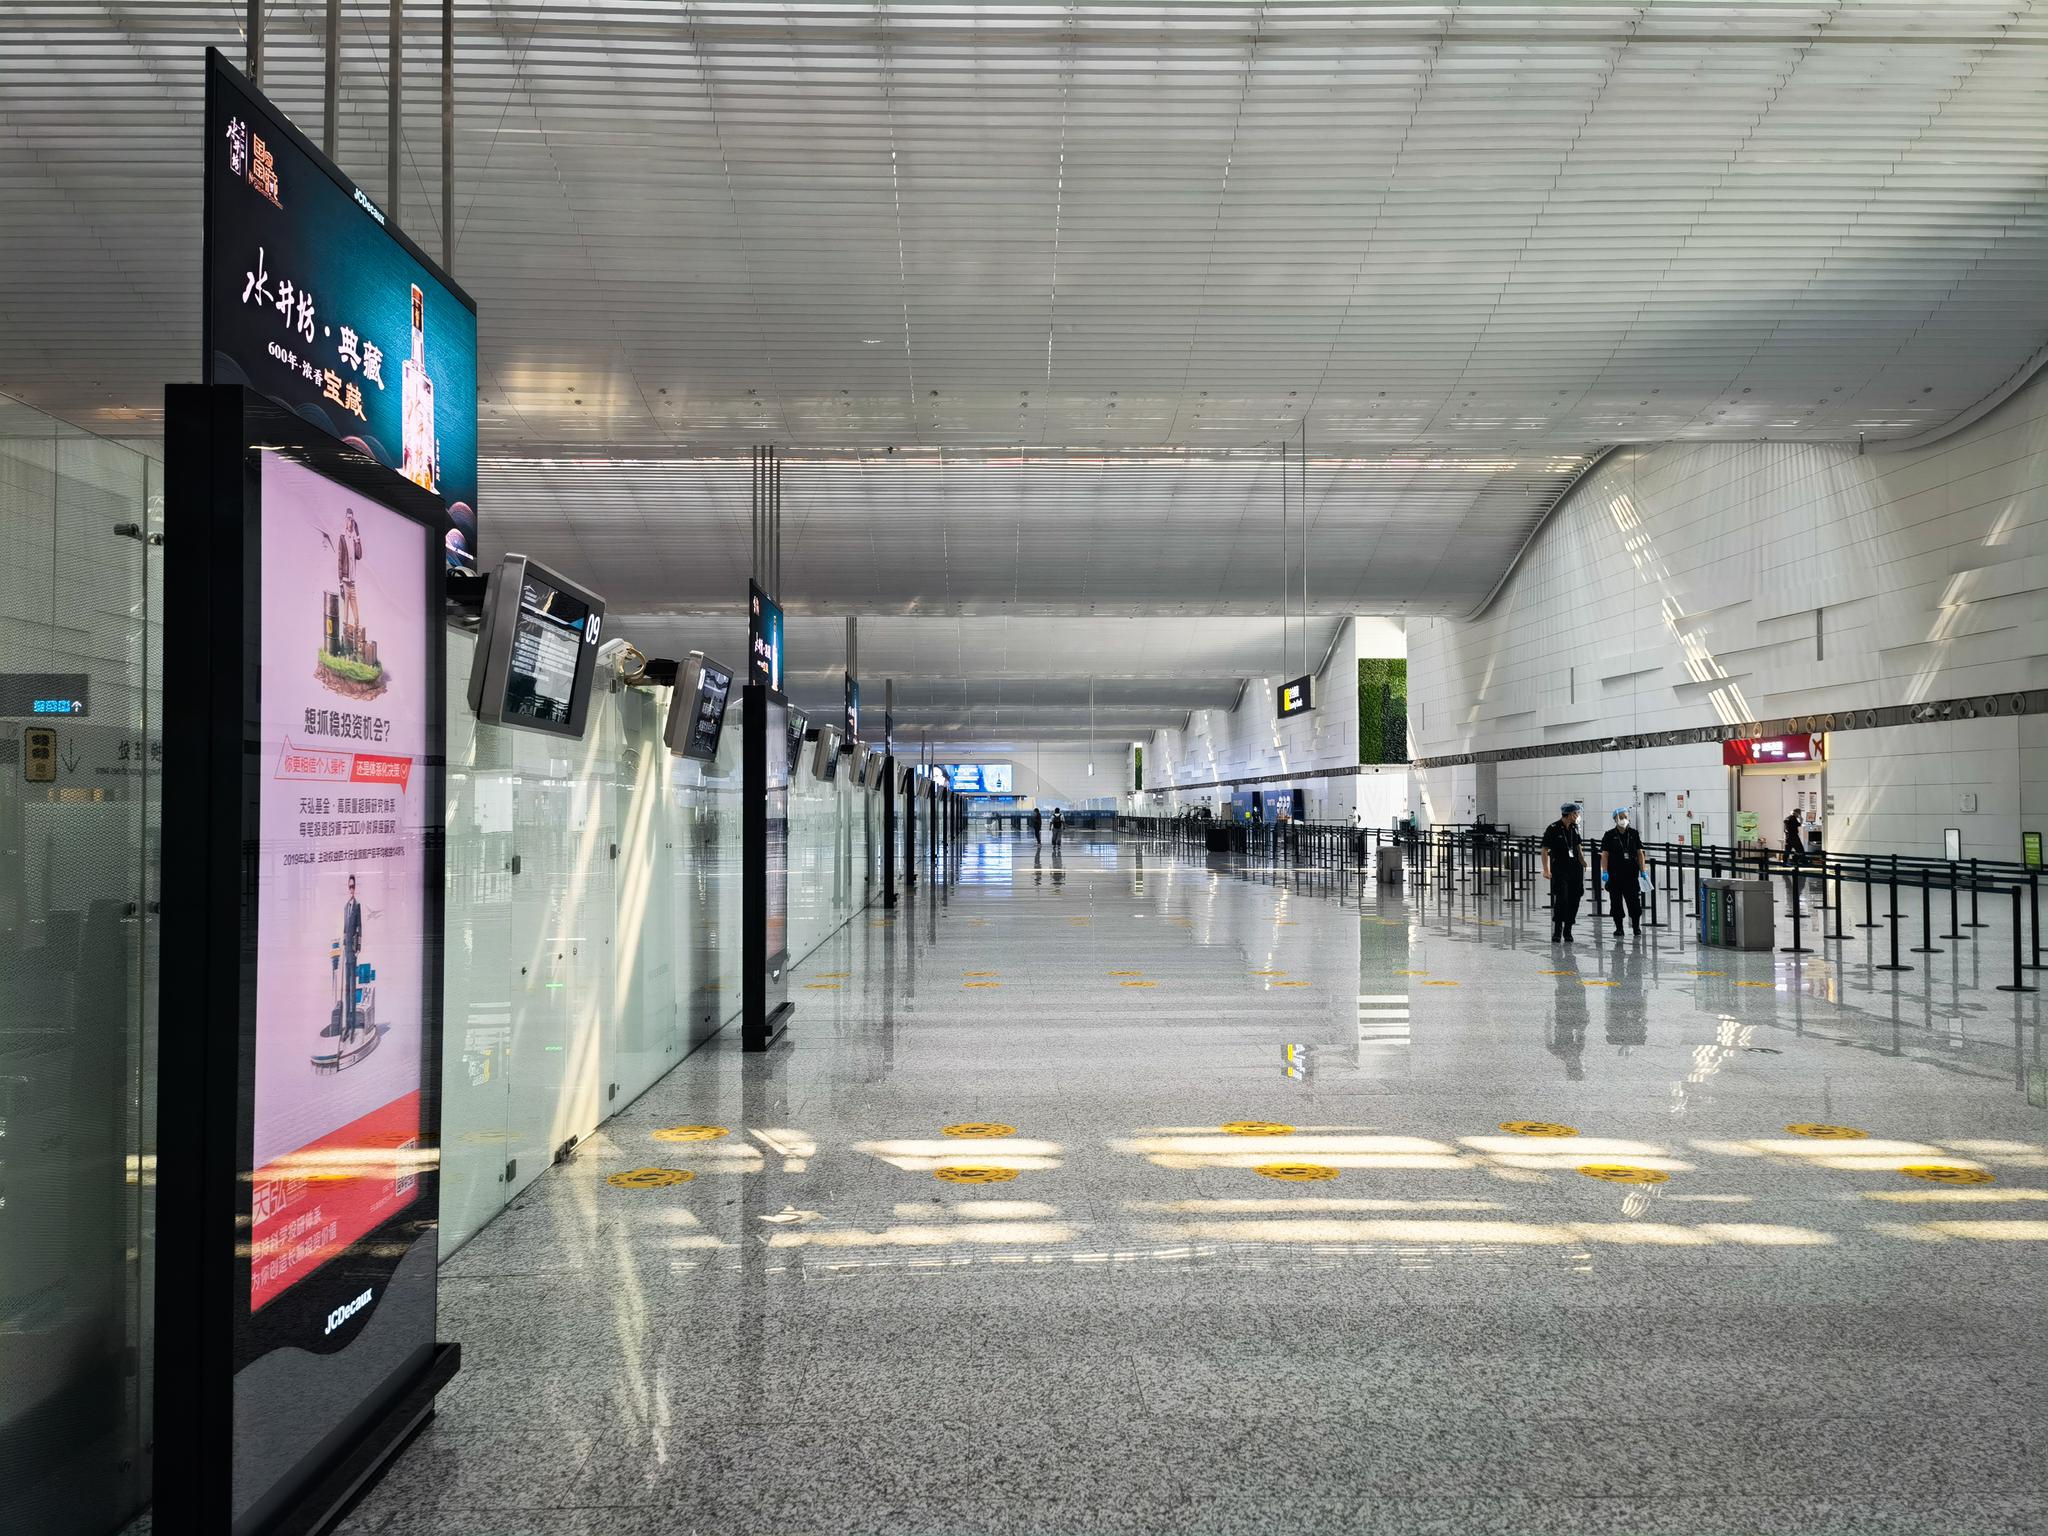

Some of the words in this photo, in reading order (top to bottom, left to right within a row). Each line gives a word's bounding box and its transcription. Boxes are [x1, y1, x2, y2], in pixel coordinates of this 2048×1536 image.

[353, 187, 385, 226] JCDecaux
[586, 613, 601, 645] 09
[324, 1287, 373, 1336] JCDecaux
